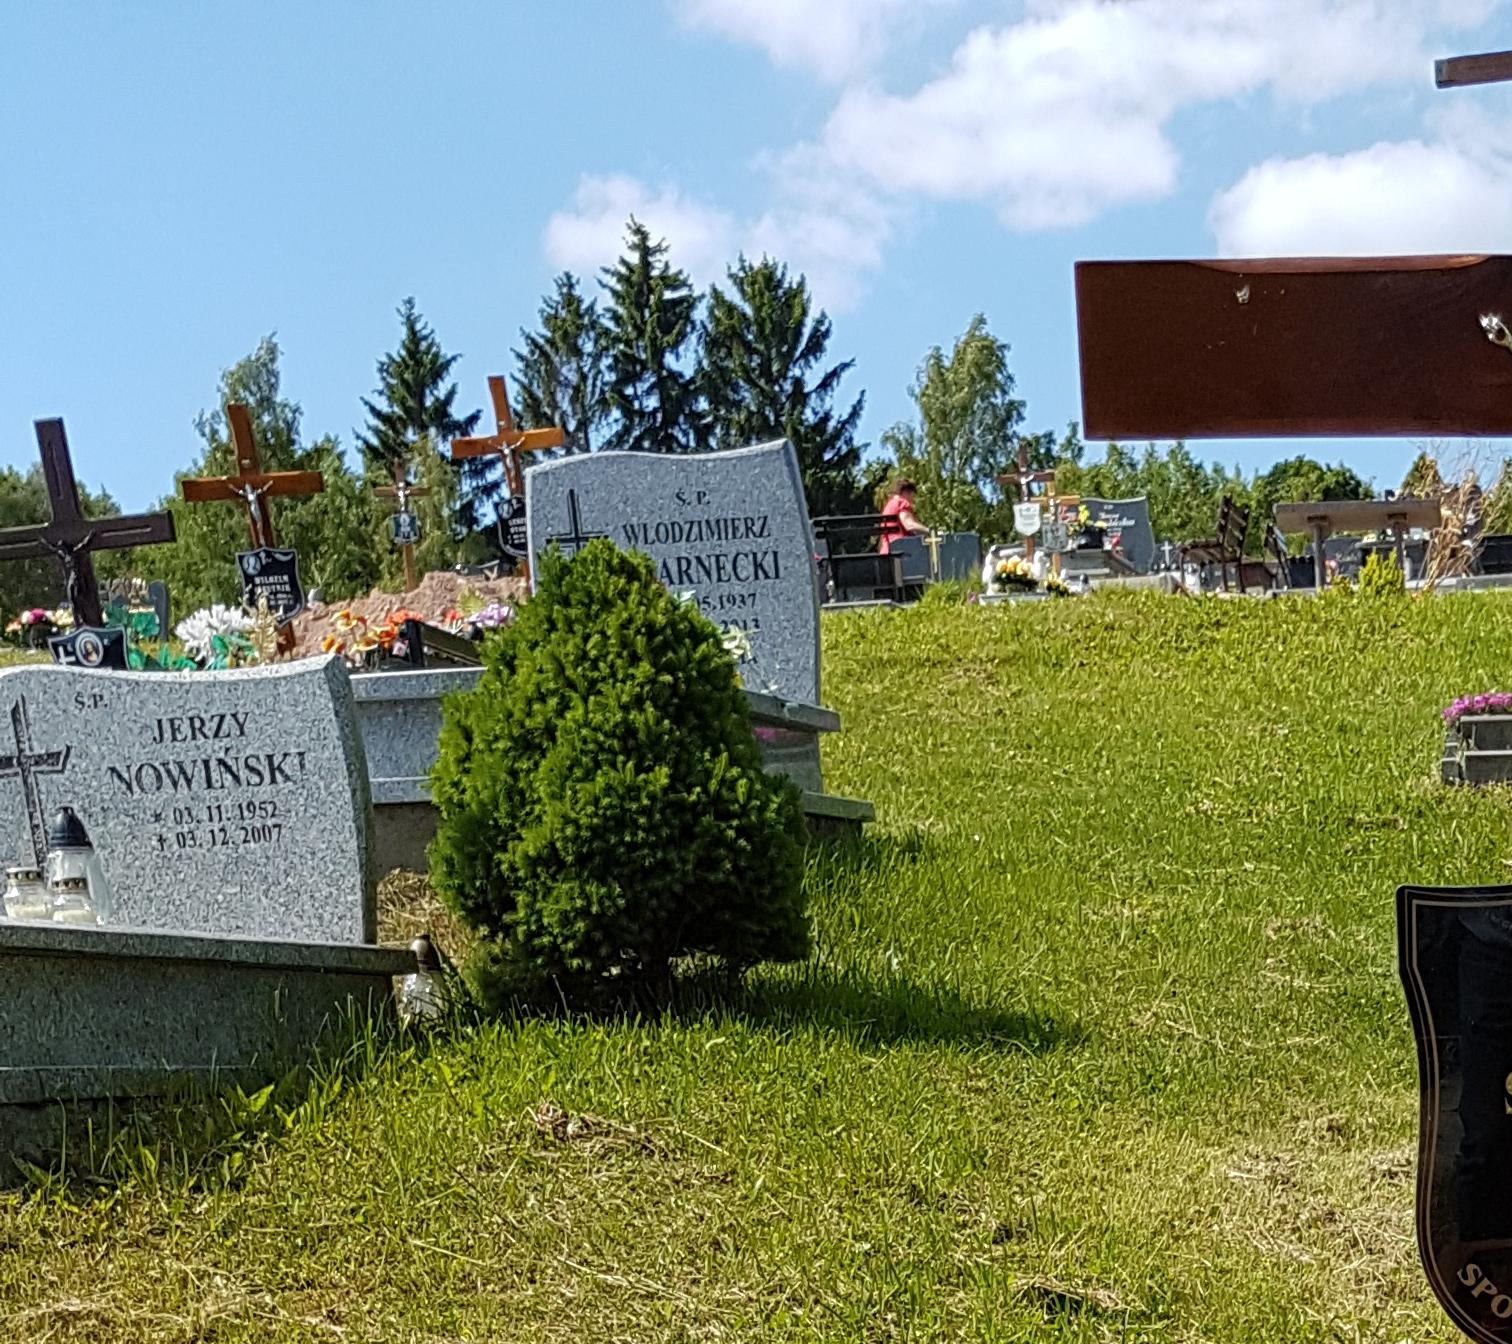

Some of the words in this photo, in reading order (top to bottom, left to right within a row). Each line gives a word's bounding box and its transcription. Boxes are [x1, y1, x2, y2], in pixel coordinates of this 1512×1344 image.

[152, 711, 249, 745] JERZY
[107, 747, 306, 797] NOWIŃSKI
[239, 823, 283, 845] 2007
